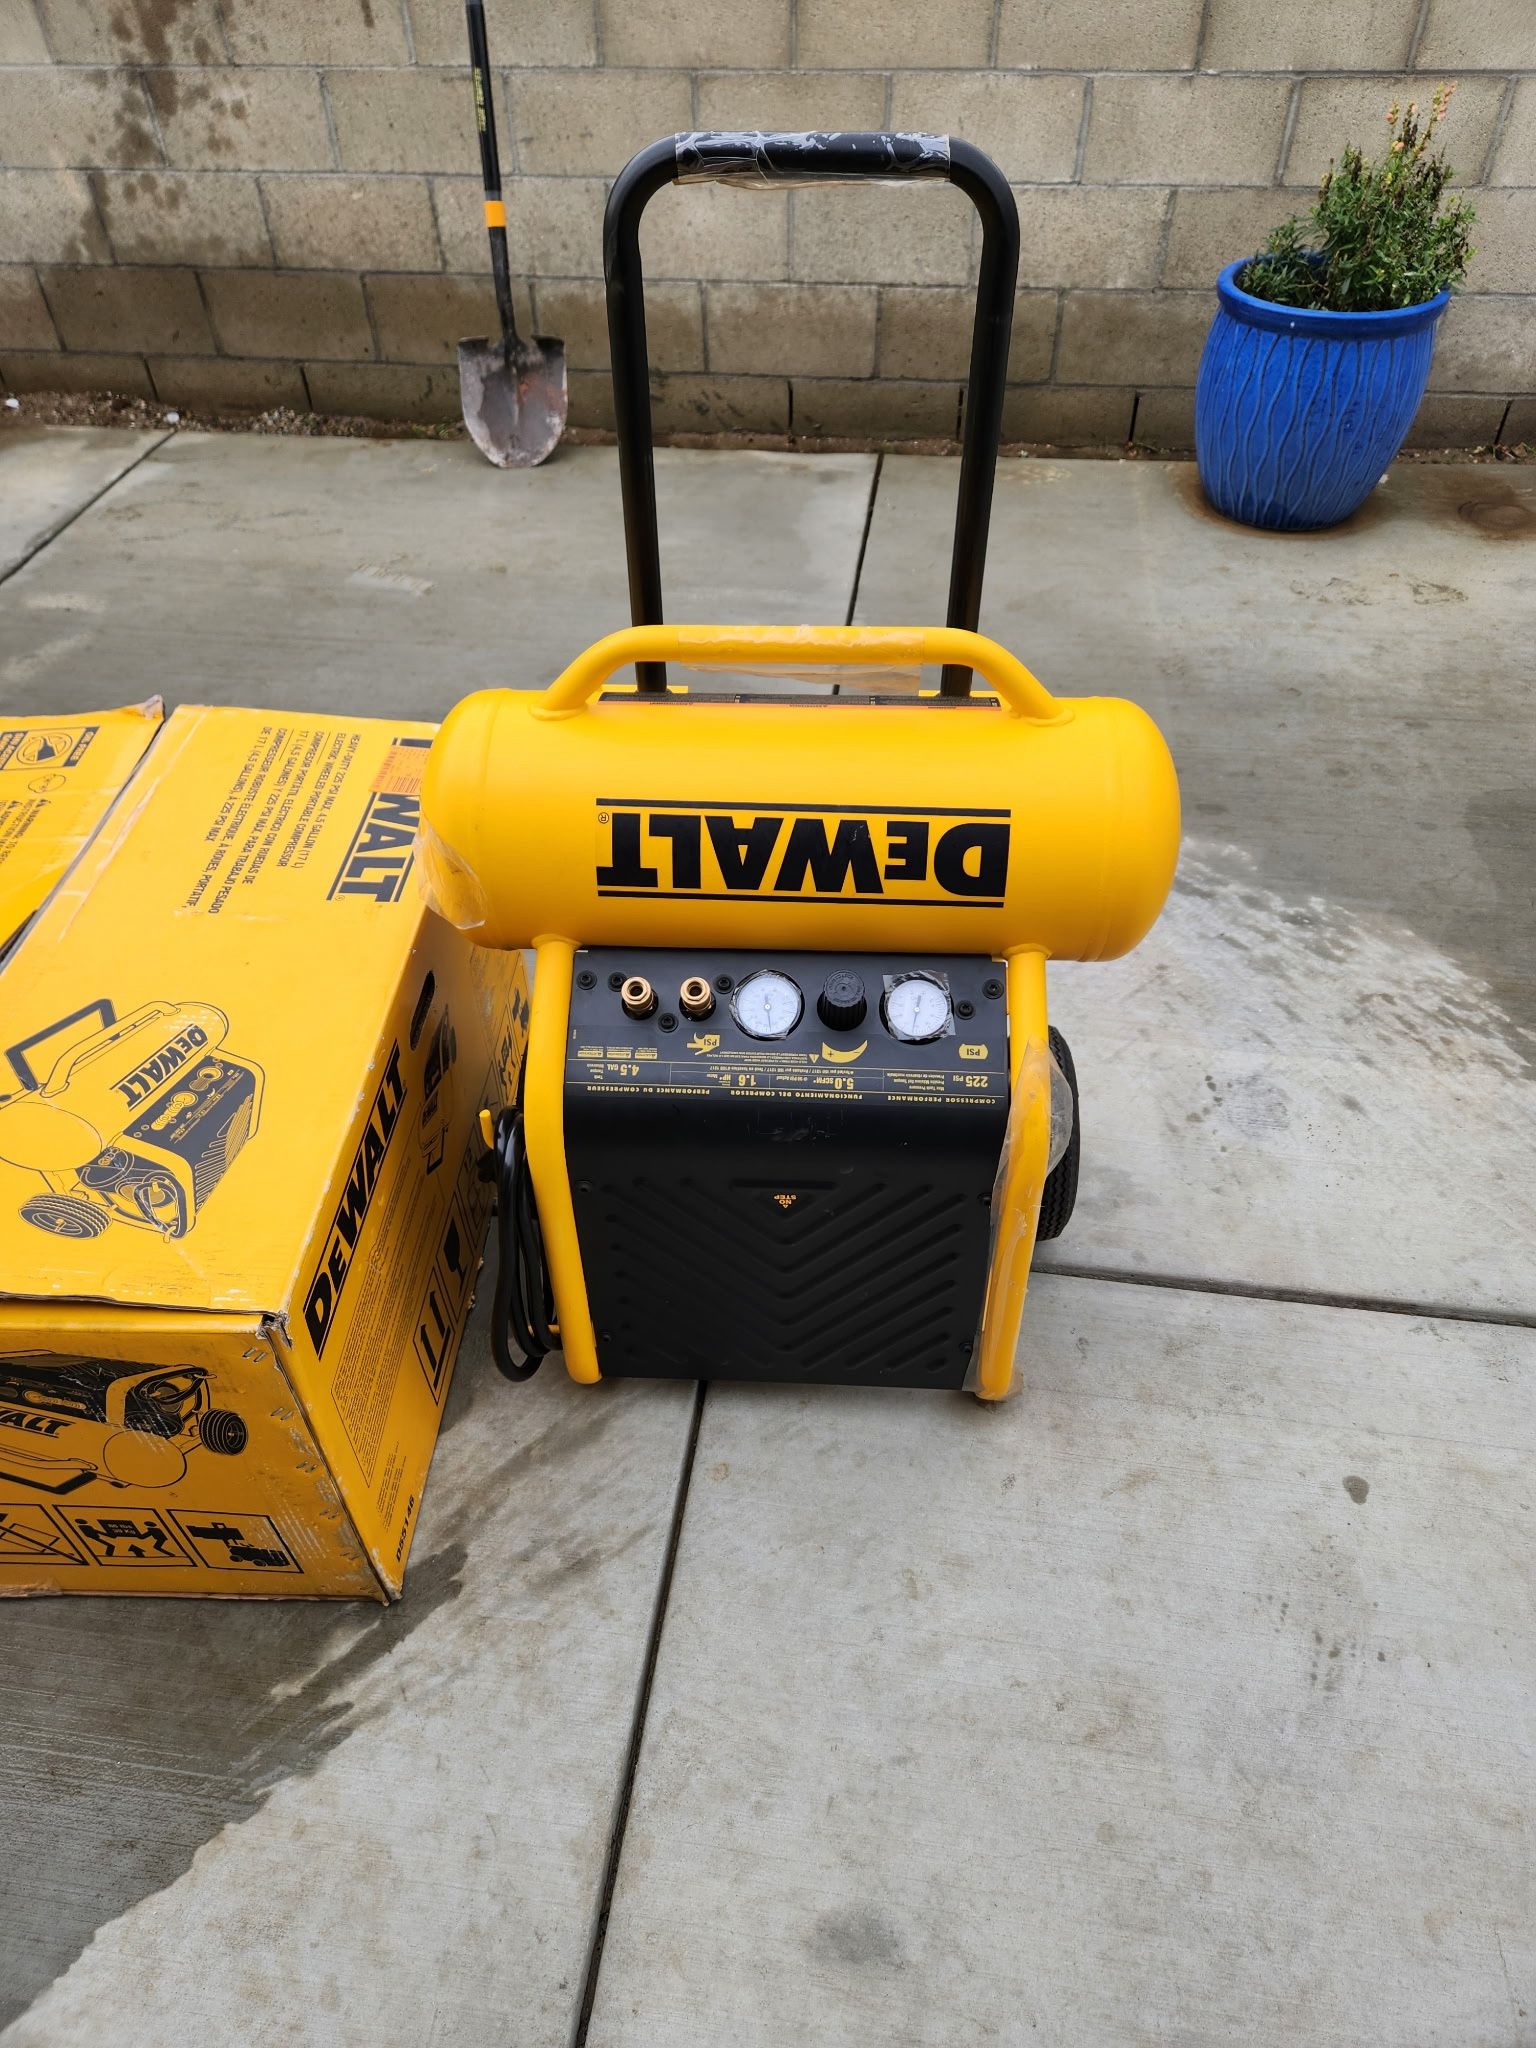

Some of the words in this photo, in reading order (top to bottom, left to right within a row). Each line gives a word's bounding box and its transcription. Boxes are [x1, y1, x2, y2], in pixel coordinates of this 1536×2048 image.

[258, 728, 287, 772] COMPRESSEUR
[301, 731, 324, 767] COMPRESOR
[328, 732, 346, 759] ELECTRIC
[339, 734, 361, 769] HEAVY-DUTY
[244, 774, 265, 801] ROBUSTE
[287, 769, 307, 797] PORTÁTIL
[315, 761, 334, 789] WHEELED
[270, 799, 296, 830] ELÉCTRICO
[299, 790, 321, 822] PORTABLE
[205, 826, 221, 841] MAX
[241, 836, 258, 852] PARA
[262, 833, 277, 845] CON
[277, 823, 306, 866] COMPRESSOR
[303, 824, 322, 848] GALLON
[248, 847, 270, 873] RUEDAS
[596, 813, 1011, 897] DEWALT
[224, 854, 248, 884] TRABAJO
[242, 875, 255, 884] DE
[207, 886, 232, 913] PESADO
[118, 1025, 208, 1108] DEWALT
[620, 1064, 639, 1076] 4.5
[738, 1075, 756, 1086] 1.6
[834, 1078, 854, 1089] 5.0
[966, 1076, 988, 1087] 225
[304, 1044, 405, 1349] DEWALT
